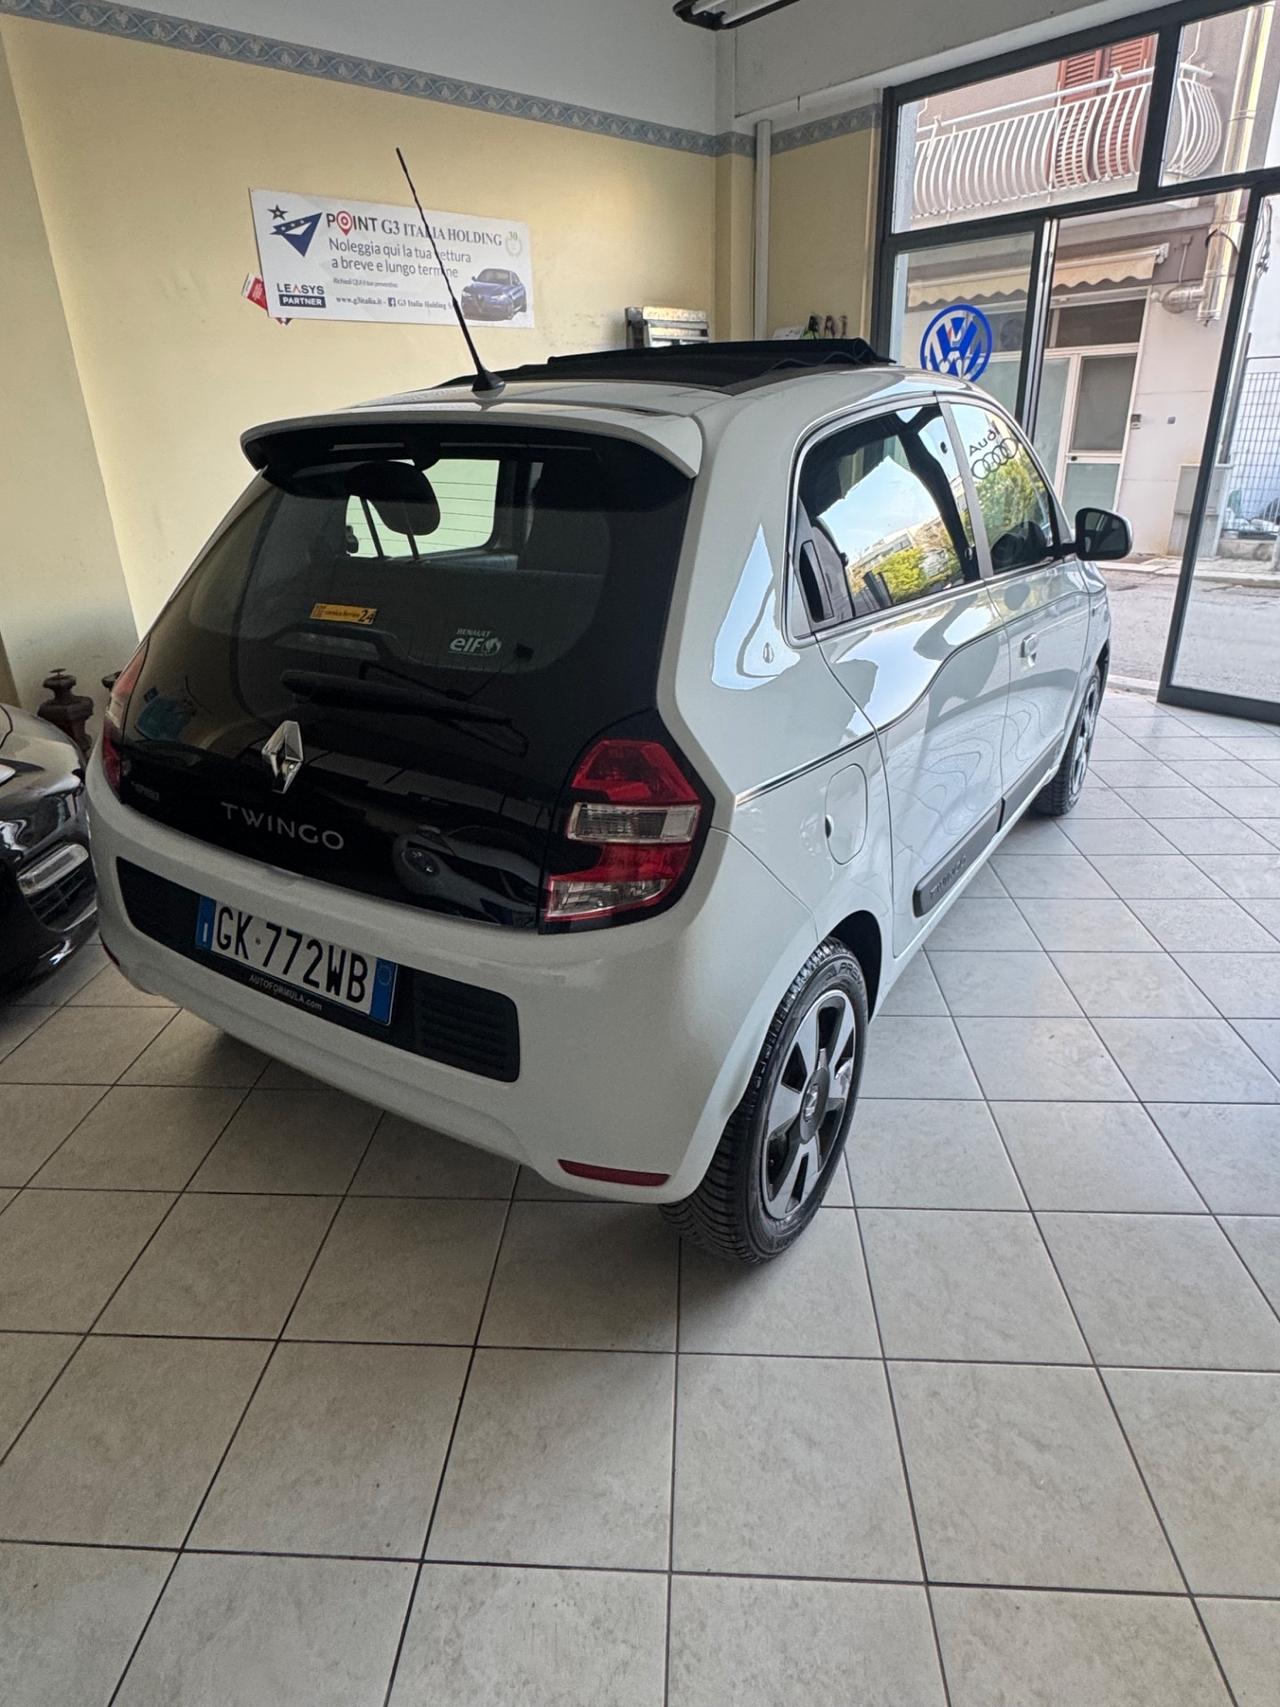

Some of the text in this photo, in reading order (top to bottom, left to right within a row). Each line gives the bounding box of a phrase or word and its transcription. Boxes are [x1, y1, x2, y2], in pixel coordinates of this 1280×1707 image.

[326, 211, 378, 235] POINT
[381, 219, 400, 235] G3
[447, 228, 502, 246] HOLDING
[329, 238, 472, 263] Noleggia qui la tua ettura
[331, 256, 458, 278] a breve e lungo termne
[276, 283, 325, 295] LEASYS
[282, 296, 322, 306] PARTNER
[969, 420, 1001, 457] Audi
[221, 802, 344, 850] TWINGO
[249, 974, 323, 1011] AUTOFORMULA.com
